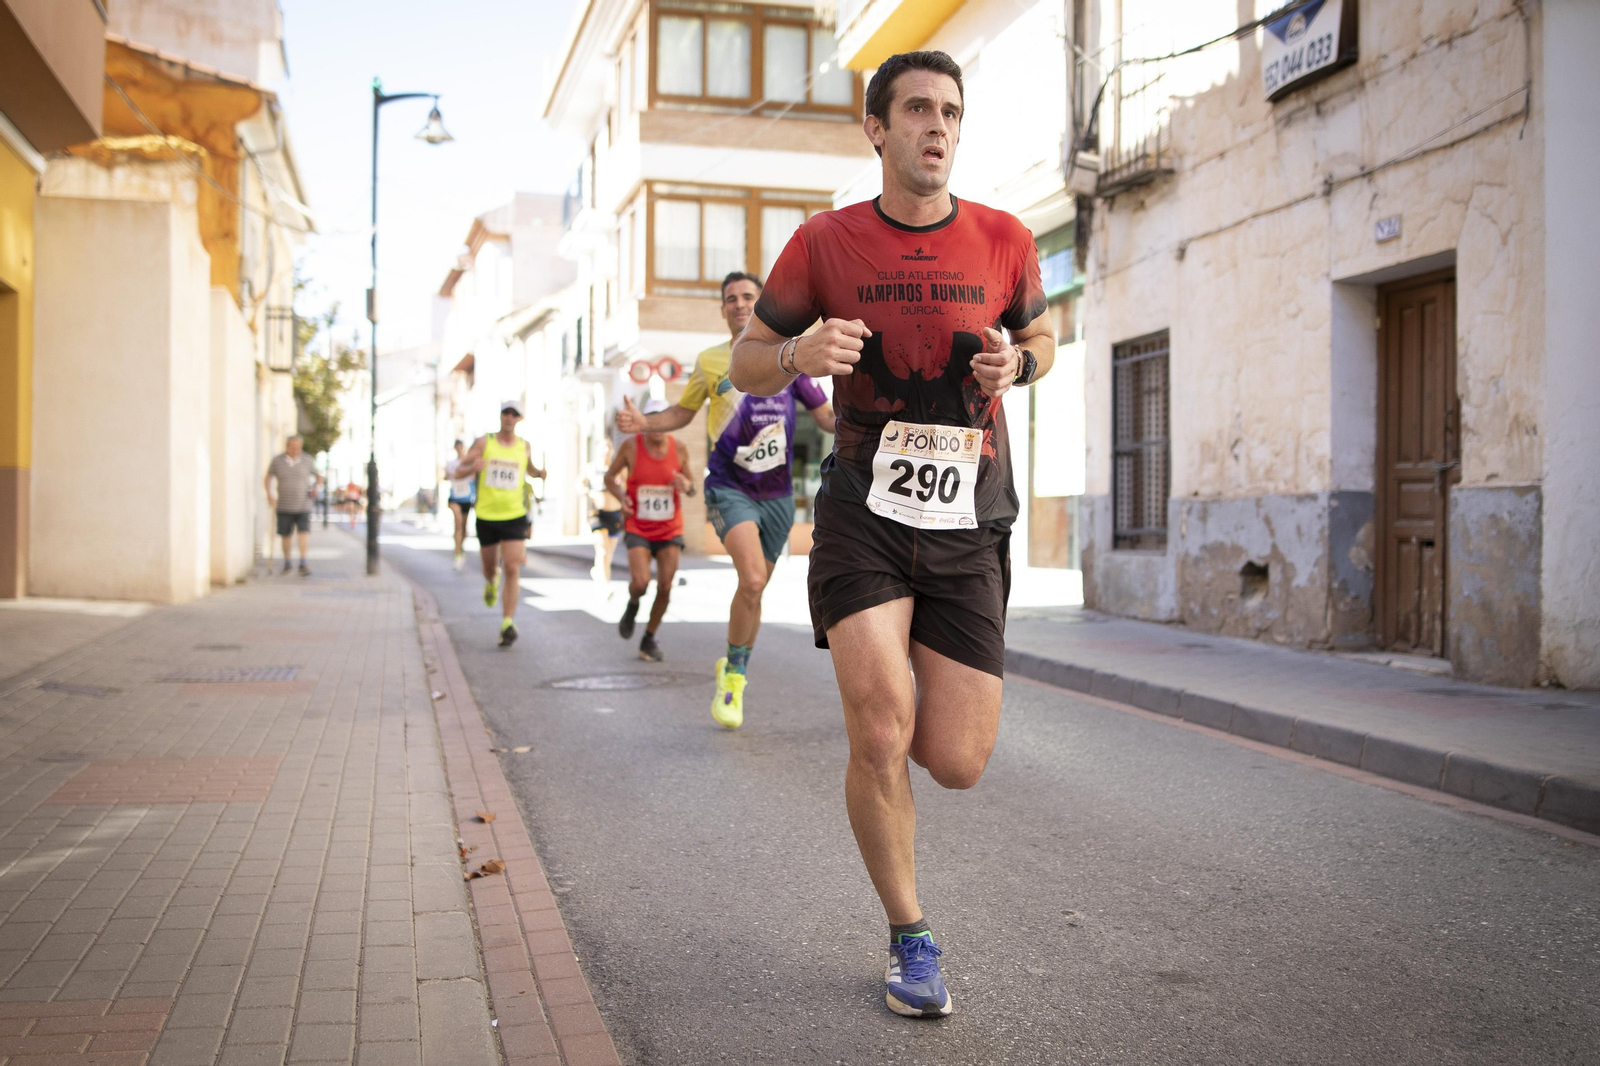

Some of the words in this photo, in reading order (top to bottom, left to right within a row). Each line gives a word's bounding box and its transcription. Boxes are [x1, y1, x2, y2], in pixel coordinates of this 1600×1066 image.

[1281, 44, 1304, 82] 044
[1307, 32, 1332, 69] 033
[877, 271, 905, 280] CLUB
[908, 271, 965, 281] ATLETISMO
[857, 283, 922, 304] VAMPIROS
[931, 283, 985, 305] RUNNING
[901, 304, 944, 315] DÚRCAL
[908, 427, 930, 436] GRAN
[904, 432, 960, 453] FONDO
[887, 459, 961, 504] 290
[645, 498, 669, 511] 161
